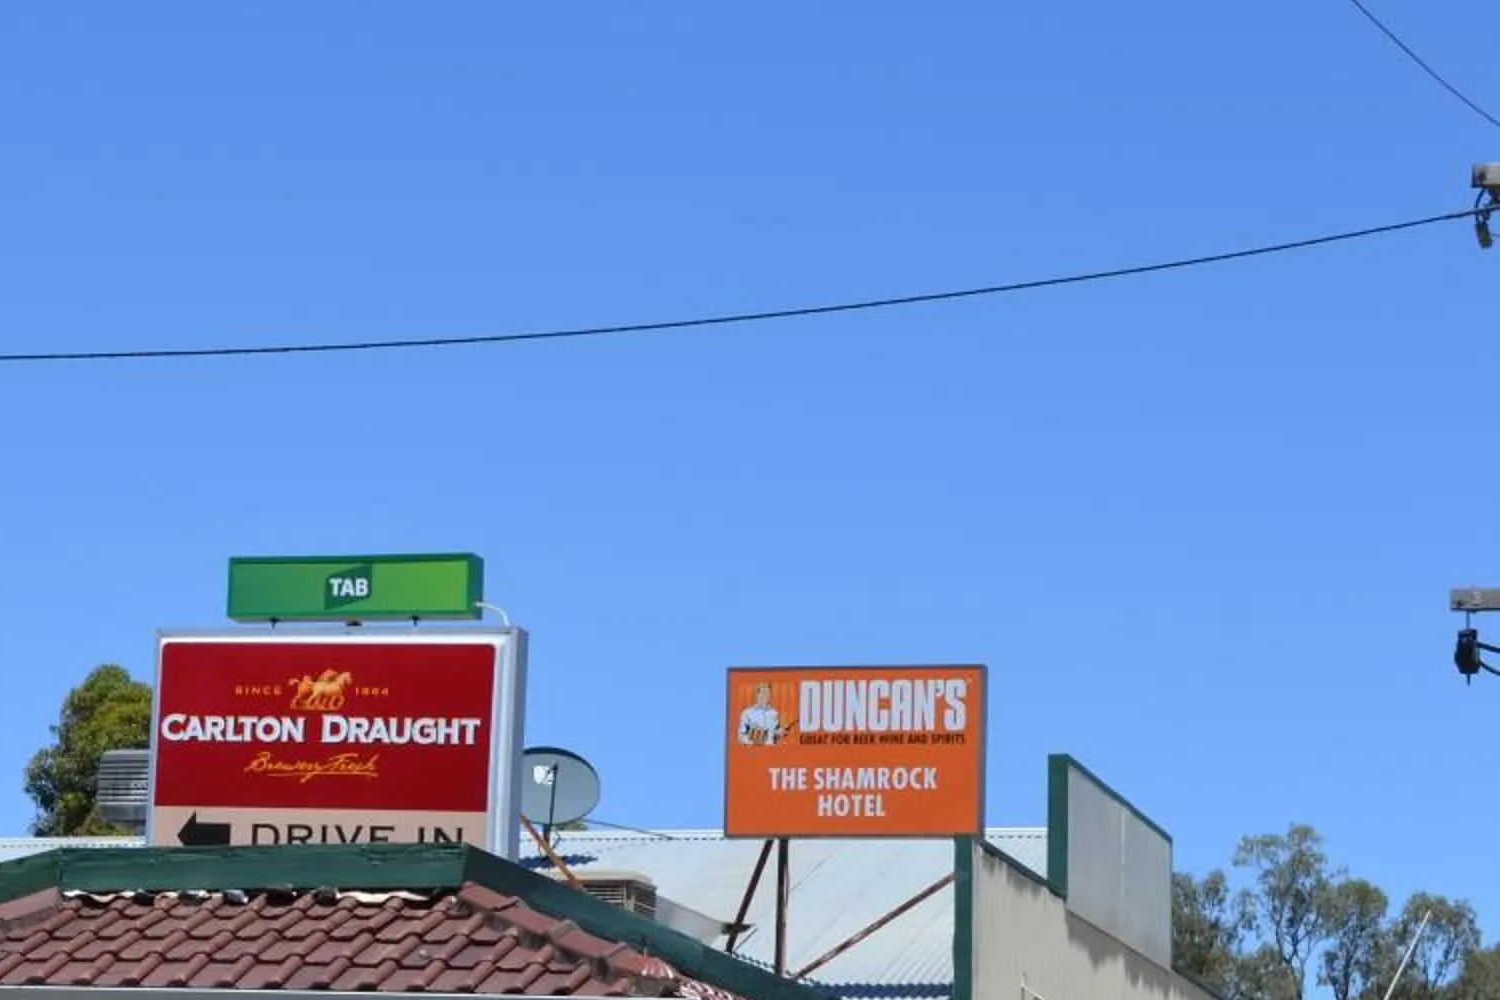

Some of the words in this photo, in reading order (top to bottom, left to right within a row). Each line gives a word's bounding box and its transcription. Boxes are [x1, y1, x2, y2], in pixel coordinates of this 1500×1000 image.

[329, 577, 369, 597] TAB
[235, 686, 282, 695] SINCE
[800, 679, 966, 732] DUNCAN'S
[161, 713, 305, 743] CARLTON
[322, 714, 481, 745] DRAUGHT
[769, 768, 806, 790] THE
[813, 767, 937, 790] SHAMROCK
[817, 795, 885, 817] HOTEL
[251, 824, 395, 845] DRIVE
